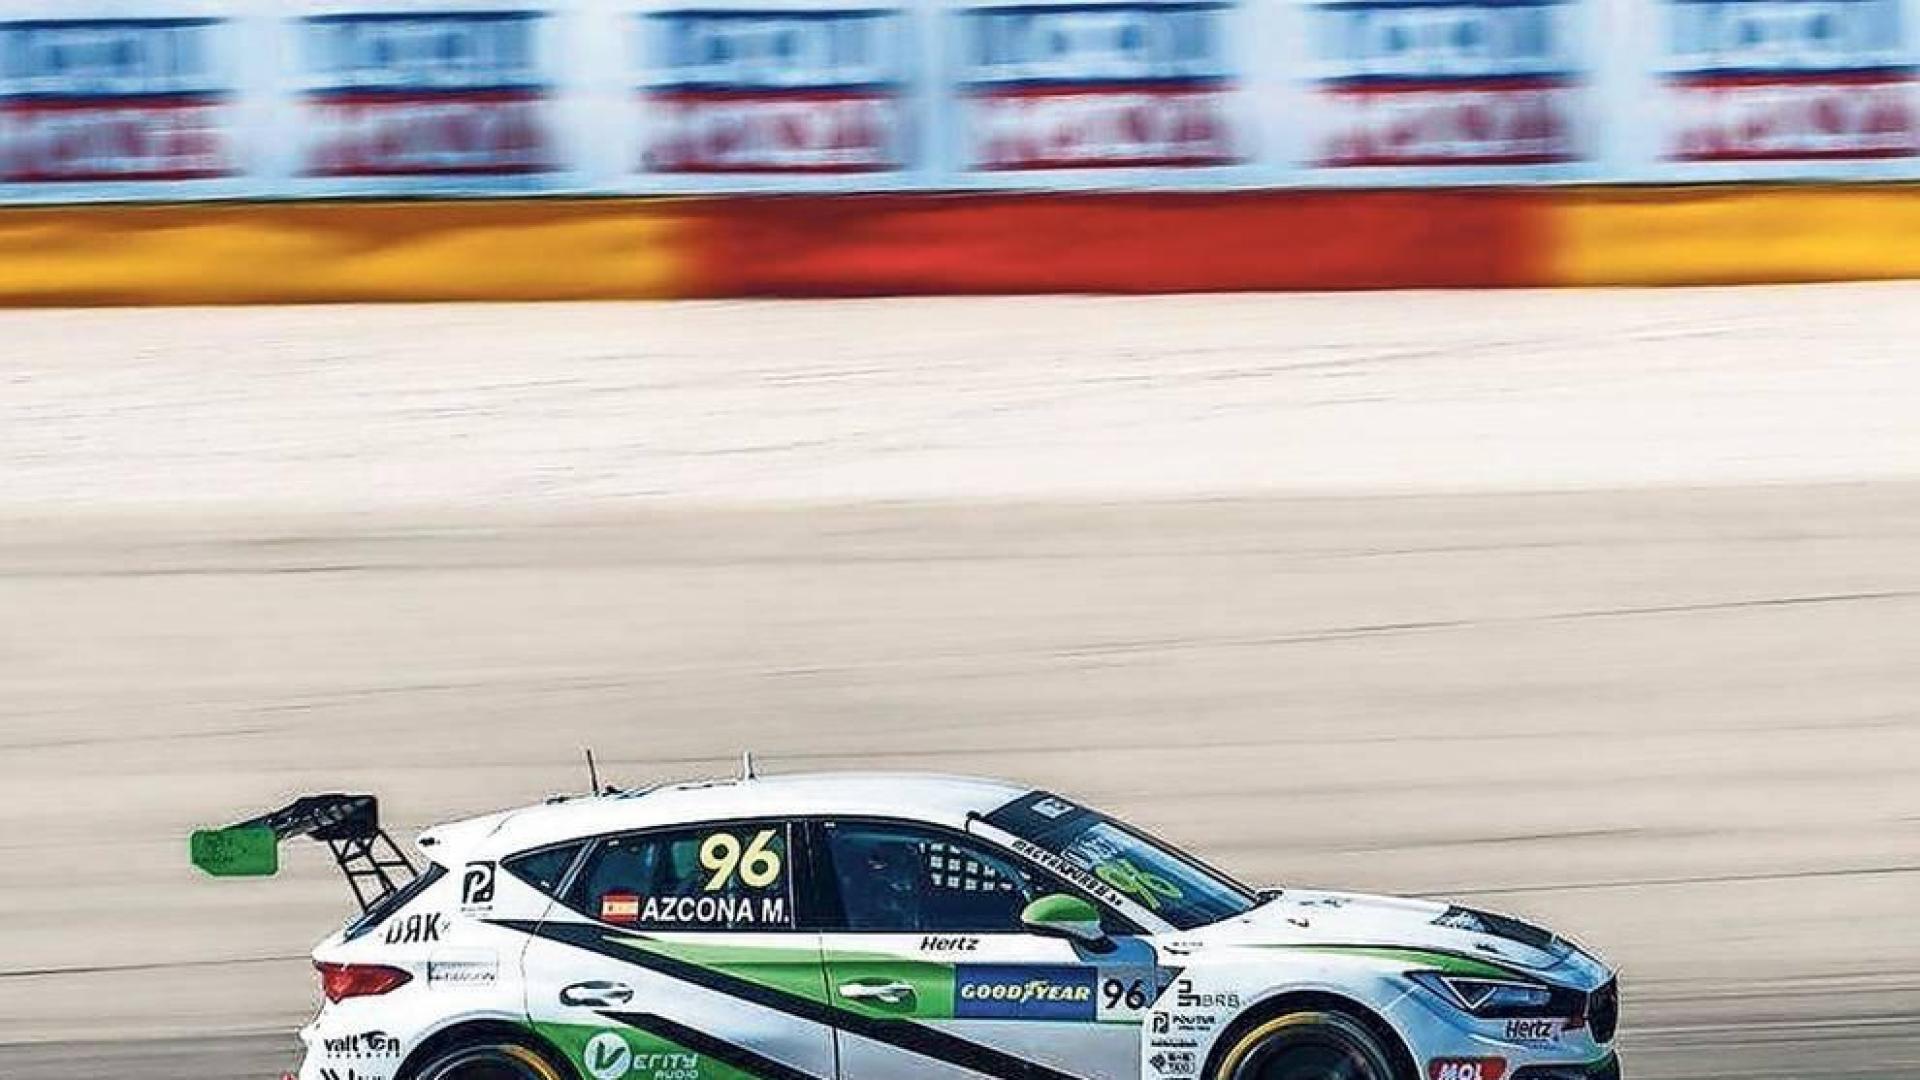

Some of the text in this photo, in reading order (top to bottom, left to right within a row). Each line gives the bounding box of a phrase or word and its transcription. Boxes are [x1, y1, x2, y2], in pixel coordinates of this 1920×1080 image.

[700, 829, 780, 891] 96
[641, 897, 789, 922] AZCONA M.
[920, 935, 980, 952] Hertz
[961, 980, 1091, 1003] GOODYEAR
[1103, 979, 1146, 1010] 96
[1506, 1019, 1551, 1038] Hertz
